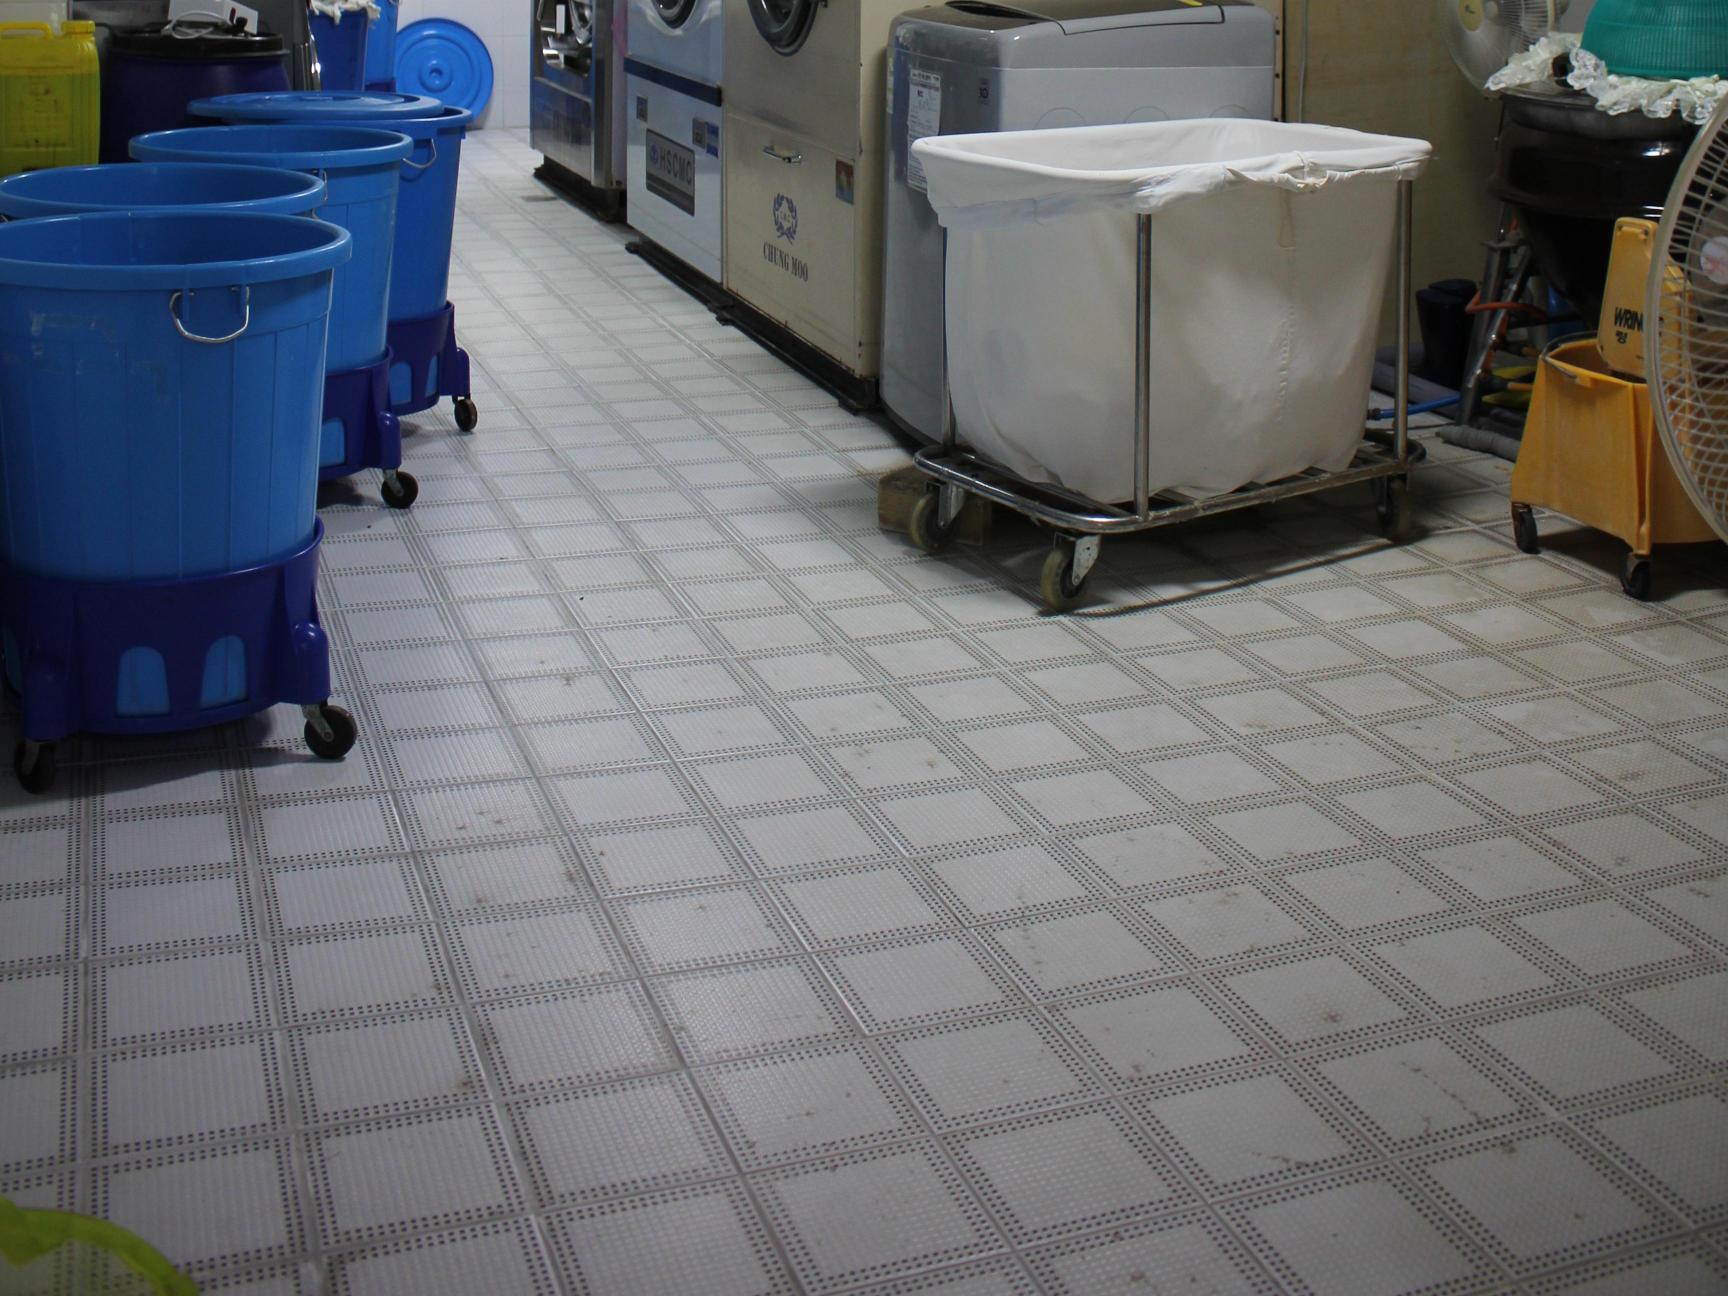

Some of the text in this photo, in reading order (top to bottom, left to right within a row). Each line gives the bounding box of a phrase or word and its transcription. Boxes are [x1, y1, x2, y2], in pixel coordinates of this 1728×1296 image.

[659, 146, 692, 186] HSCMC
[763, 241, 809, 283] CHUNG MOO
[1614, 306, 1644, 332] WRIN
